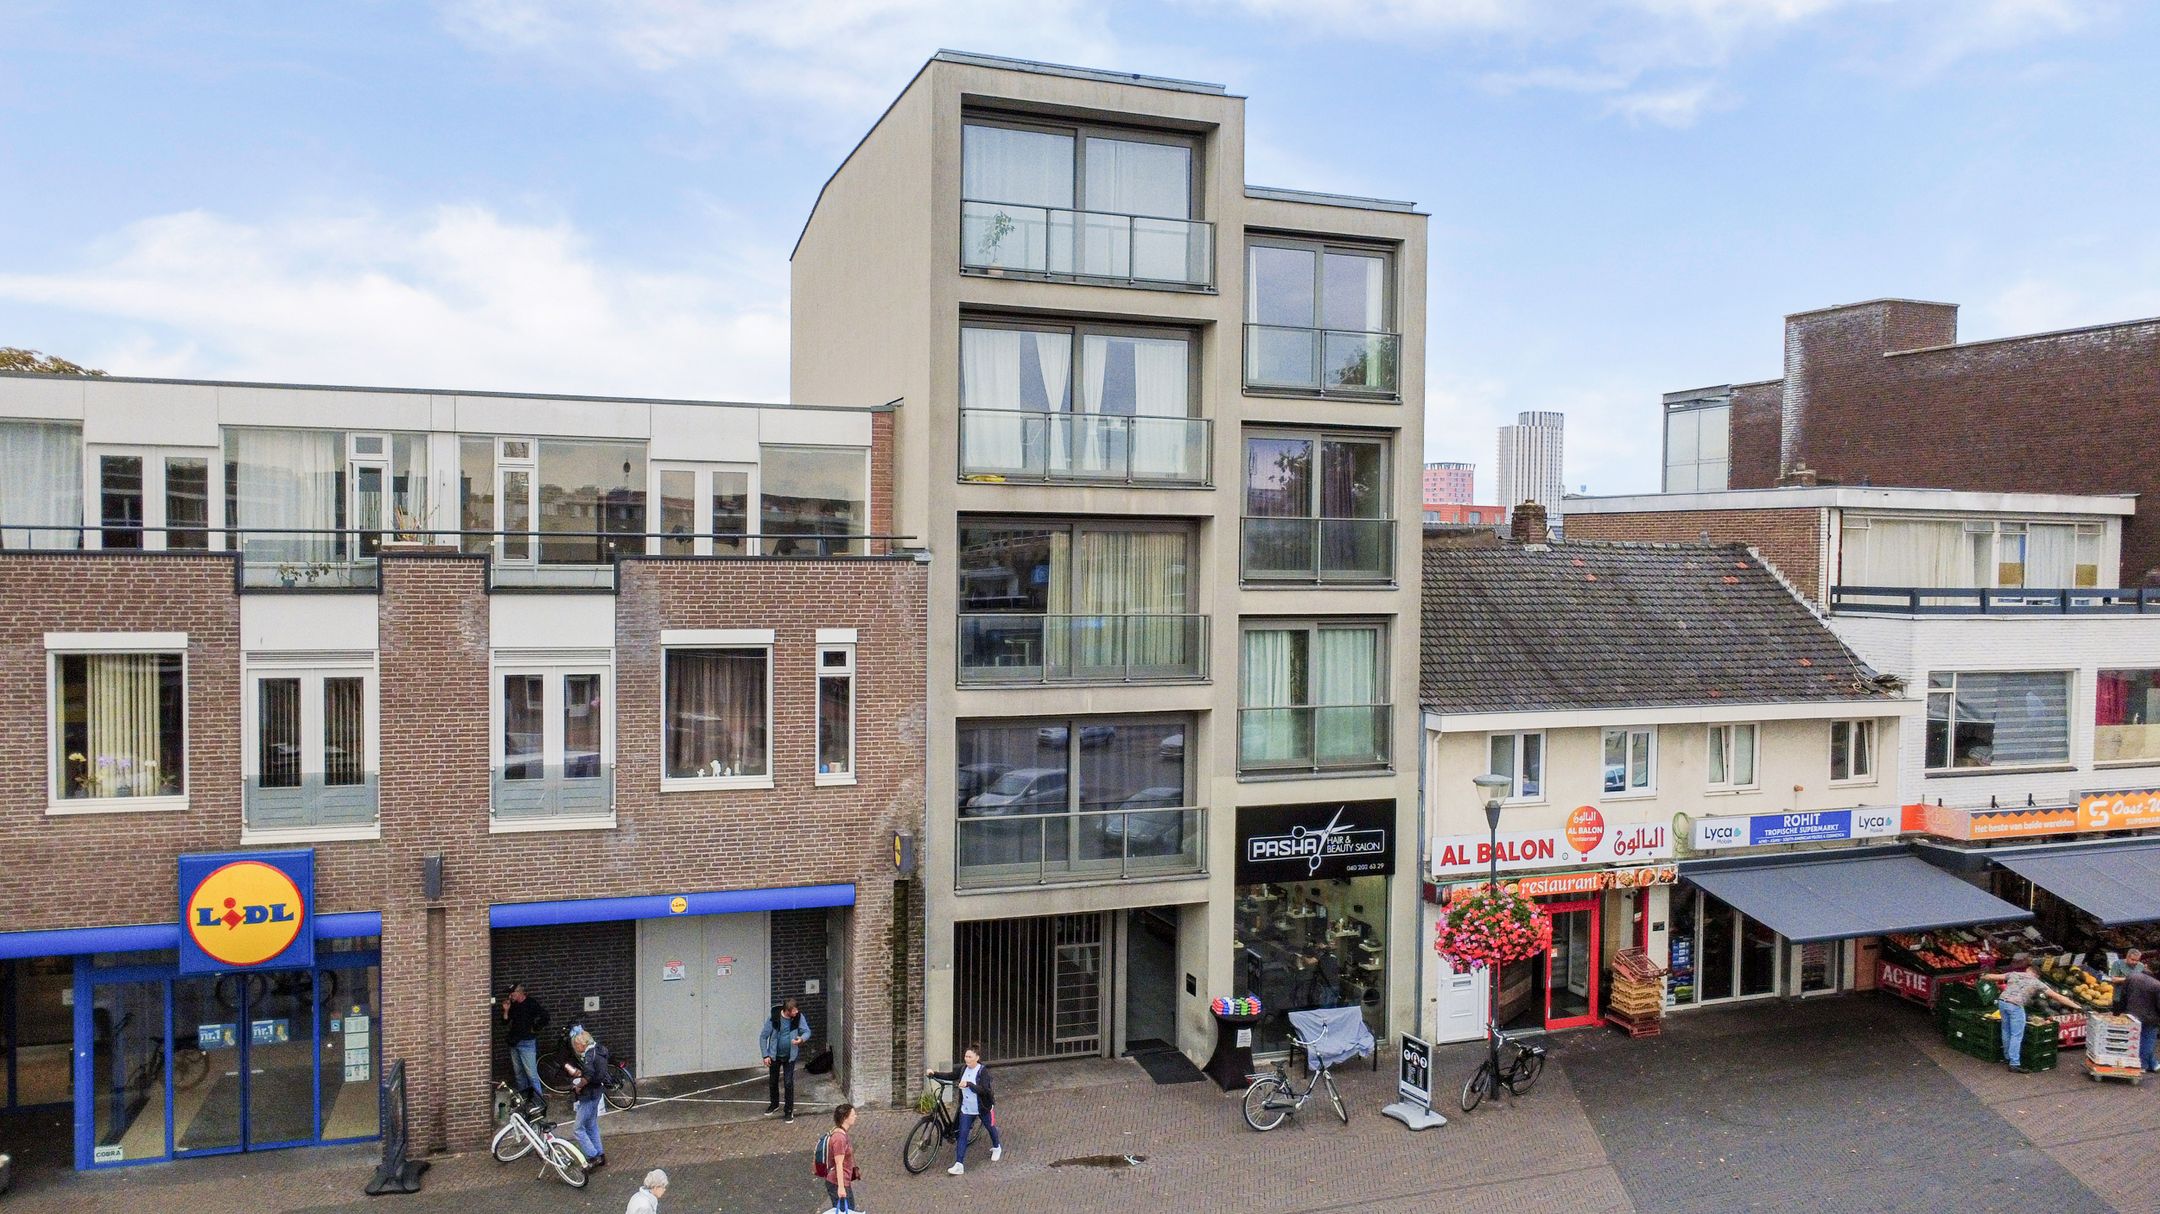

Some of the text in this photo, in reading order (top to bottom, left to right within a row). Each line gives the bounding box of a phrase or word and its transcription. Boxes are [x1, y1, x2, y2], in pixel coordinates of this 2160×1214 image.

[1784, 813, 1820, 827] ROHIT
[1859, 815, 1884, 829] Lyca
[1568, 826, 1603, 835] AL BALON
[1704, 826, 1733, 840] Lyca
[1764, 824, 1839, 836] TROPISCHE SUPERMARKT
[1975, 824, 1988, 833] Het
[1989, 823, 2008, 832] beste
[2009, 823, 2023, 831] van
[1327, 835, 1352, 844] HAIR &
[1614, 826, 1664, 856] البالون
[1253, 838, 1317, 858] PASHA
[1327, 842, 1380, 853] BEAUTY SALON
[1440, 838, 1554, 866] AL BALON
[1521, 874, 1598, 895] restaurant
[1883, 964, 1927, 992] ACTIE
[96, 1150, 121, 1158] COBRA
